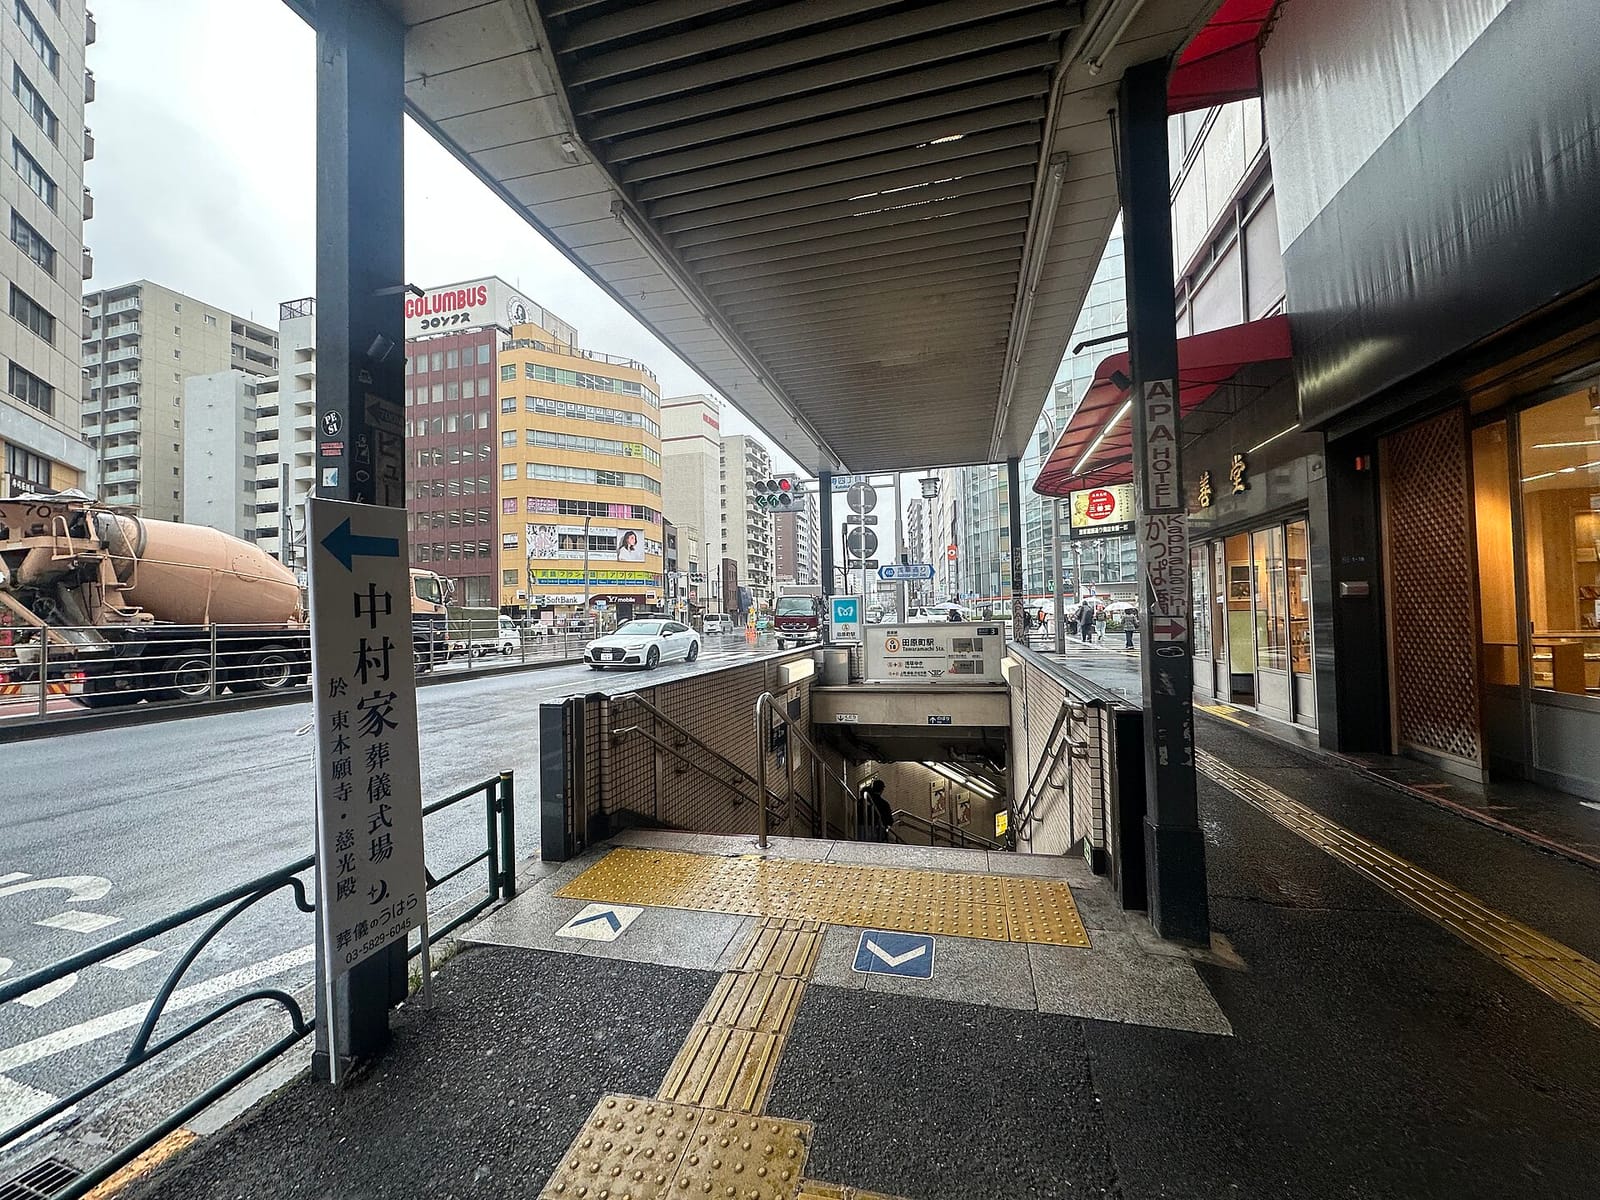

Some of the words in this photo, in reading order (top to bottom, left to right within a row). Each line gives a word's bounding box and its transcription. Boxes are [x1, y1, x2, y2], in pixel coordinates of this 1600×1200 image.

[405, 285, 487, 318] COLUMBUS
[324, 412, 337, 425] PE
[328, 422, 338, 434] SI
[1147, 381, 1175, 443] APA
[1153, 447, 1172, 508] HOTEL
[546, 596, 578, 604] SoftBank
[902, 638, 935, 646] 田原町駅
[335, 892, 418, 952] 葬儀のうはら
[345, 917, 411, 965] 03-5829-6045
